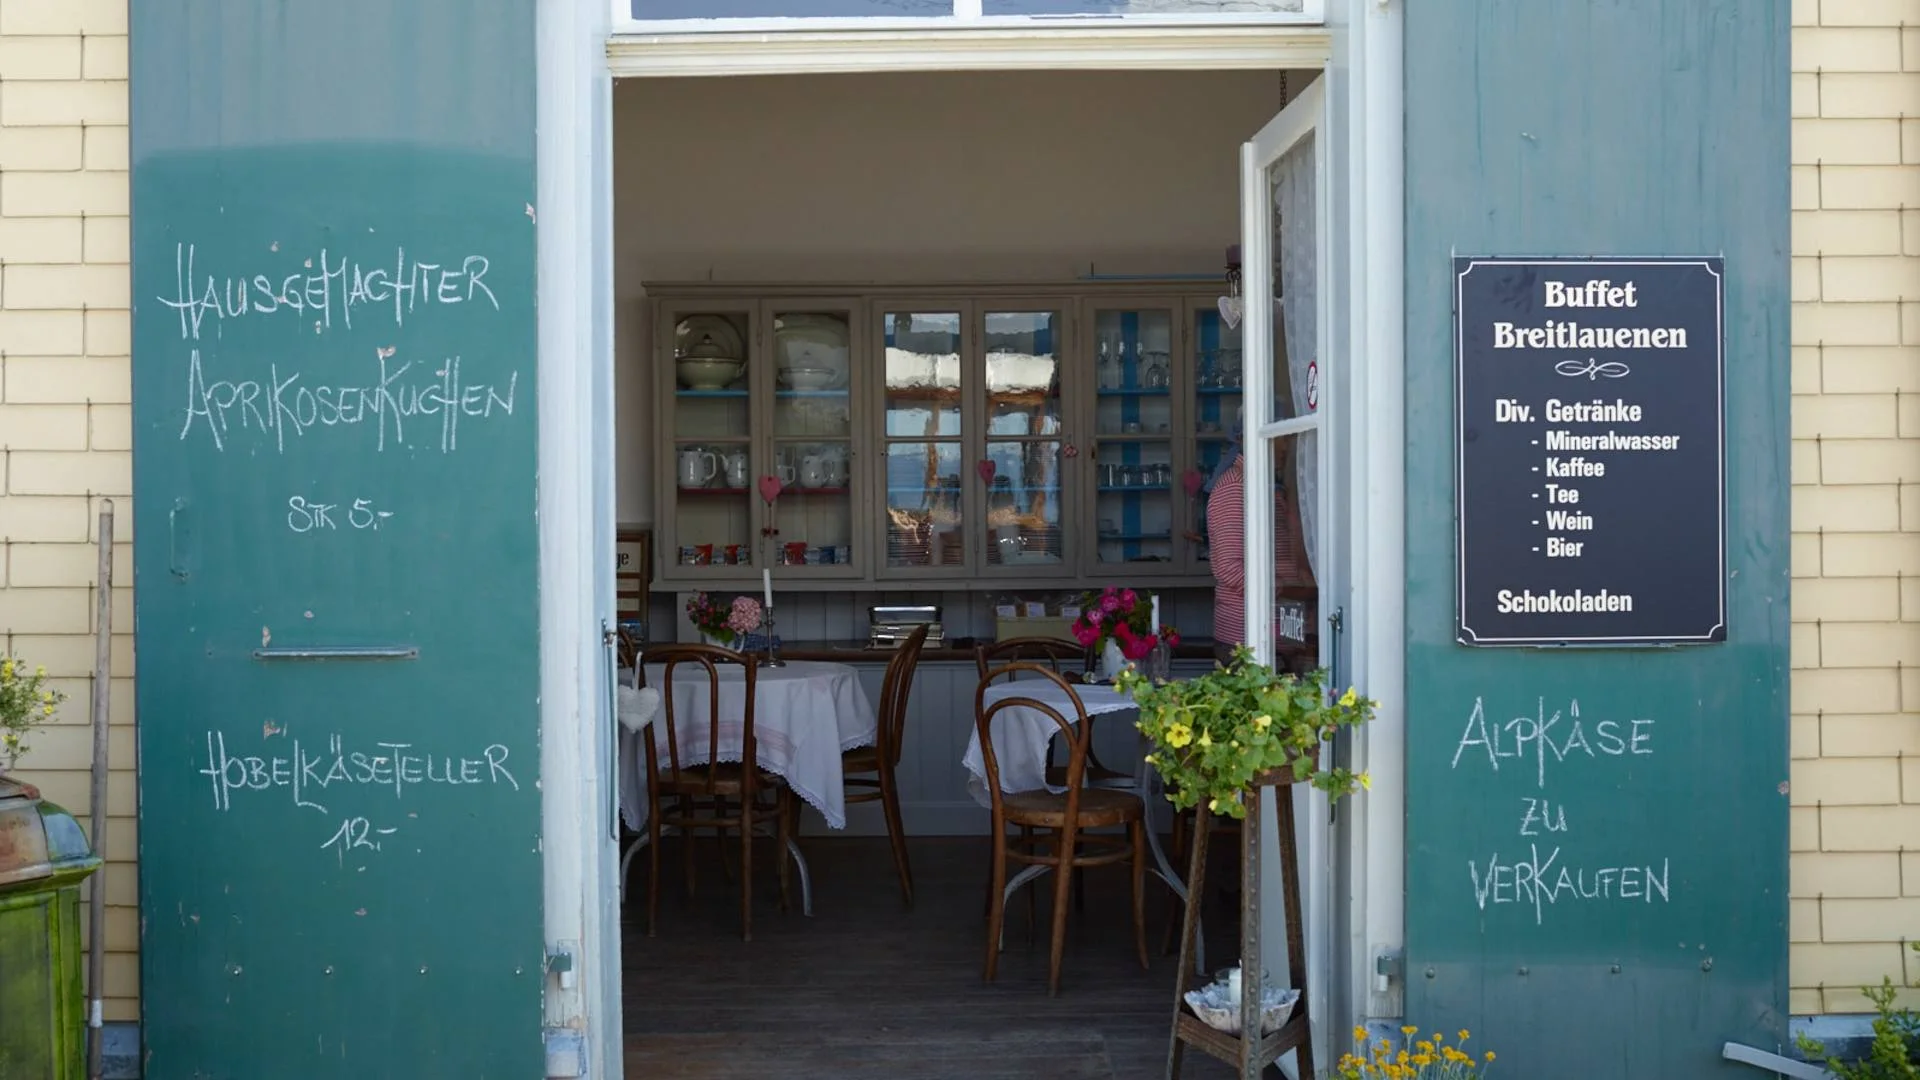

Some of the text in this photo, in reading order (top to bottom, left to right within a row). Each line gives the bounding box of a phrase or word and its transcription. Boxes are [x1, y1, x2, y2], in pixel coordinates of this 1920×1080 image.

[157, 243, 499, 340] HAUSGEMACHTER
[1544, 280, 1638, 308] Buffet
[1493, 320, 1688, 349] Breitlauenen
[180, 349, 518, 453] APRIKOSENKUCHEN
[1495, 399, 1642, 423] Div. Getränke
[1545, 431, 1680, 451] Mineralwasser
[1546, 458, 1605, 477] Kaffee
[1546, 485, 1579, 504] Tee
[1546, 511, 1593, 530] Wein
[1546, 537, 1584, 557] Bier
[1497, 589, 1633, 613] Schokoladen
[1279, 606, 1304, 642] Buffet
[1469, 843, 1669, 925] VERKAUFEN
